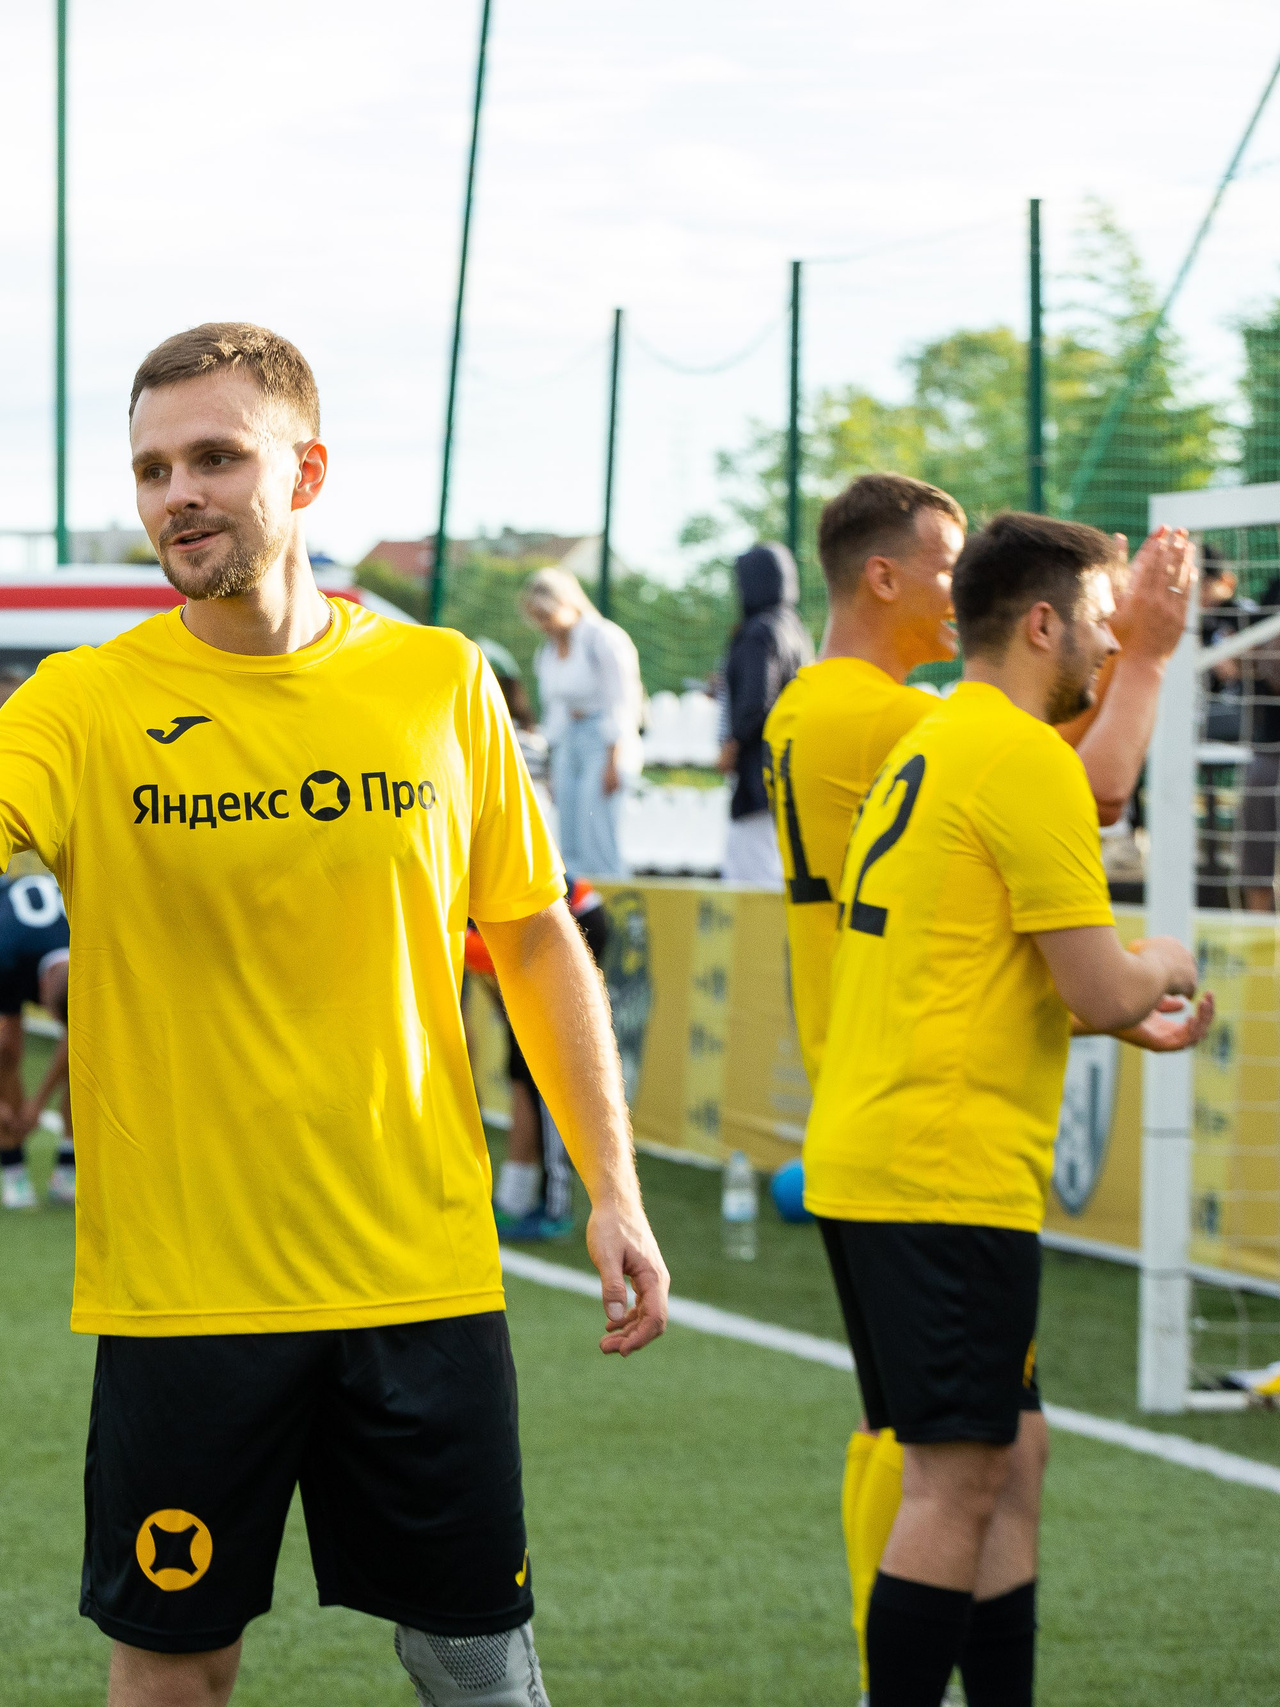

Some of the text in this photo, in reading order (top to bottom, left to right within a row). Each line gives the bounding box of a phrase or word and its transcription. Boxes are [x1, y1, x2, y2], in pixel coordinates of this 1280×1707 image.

[132, 771, 437, 830] Яндекс Про
[762, 737, 834, 904] 1
[837, 754, 926, 938] 2
